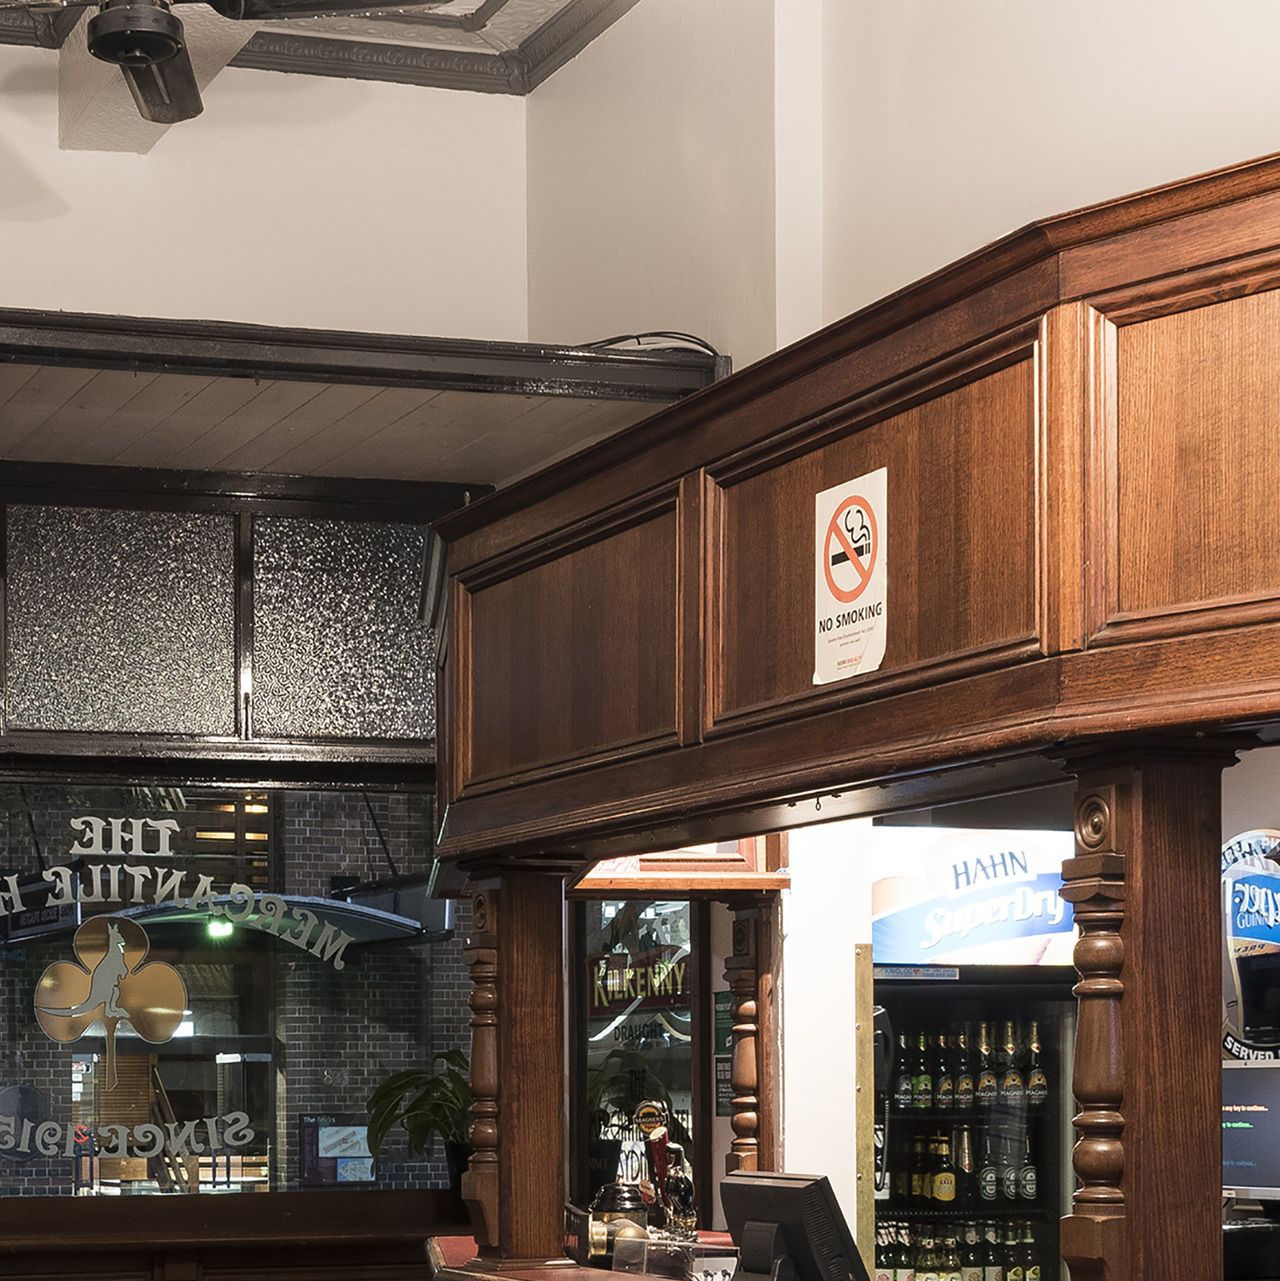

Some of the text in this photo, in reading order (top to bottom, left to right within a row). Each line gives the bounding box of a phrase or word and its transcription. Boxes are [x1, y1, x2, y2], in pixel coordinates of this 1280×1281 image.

[819, 602, 882, 634] NO SMOKING
[952, 851, 1028, 889] HAHN
[921, 886, 1065, 950] SuperDry
[594, 962, 686, 1008] KILKENNY
[614, 1023, 663, 1041] DRAUGHT
[1224, 1036, 1274, 1061] SERVED
